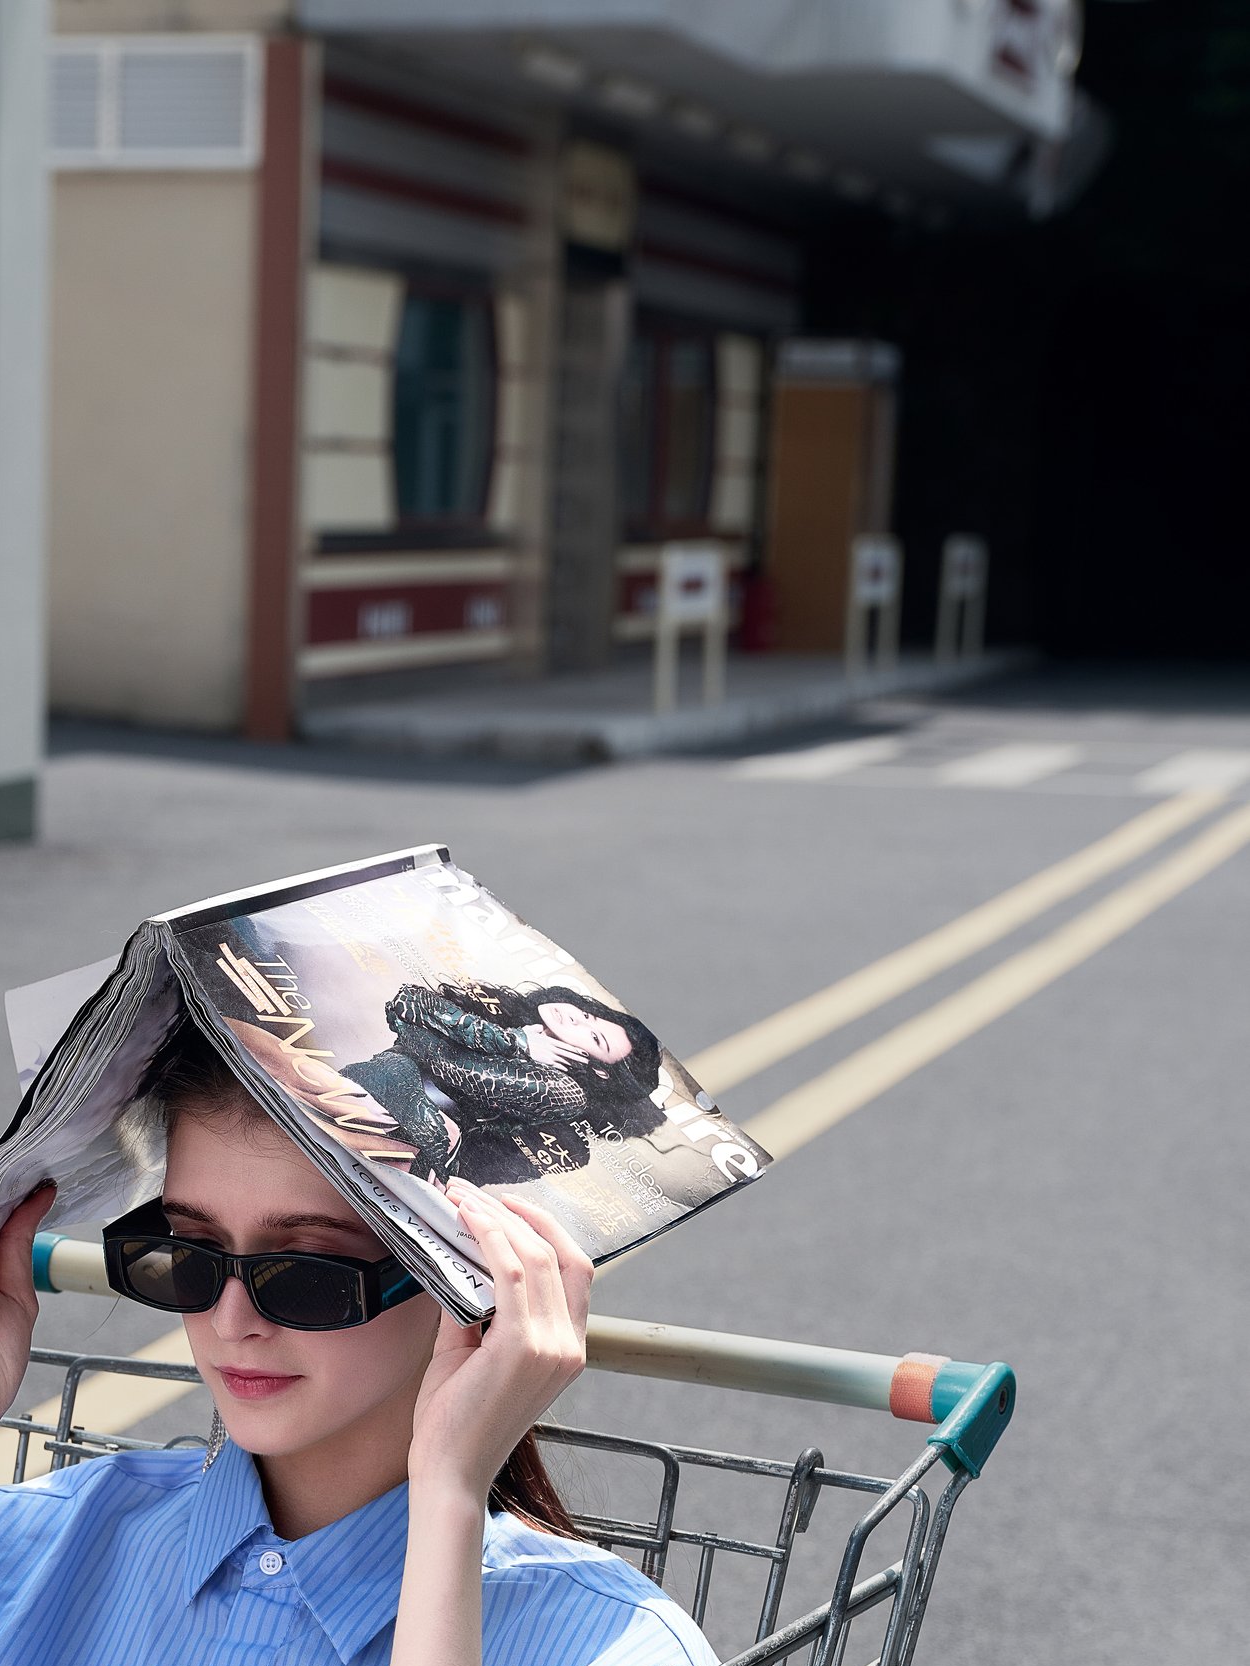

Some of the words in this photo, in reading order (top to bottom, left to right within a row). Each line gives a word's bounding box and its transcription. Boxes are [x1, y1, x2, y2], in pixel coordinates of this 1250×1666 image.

[255, 954, 312, 1011] The
[256, 1014, 386, 1135] New
[569, 1121, 595, 1149] Furry
[579, 1120, 601, 1143] Pink
[598, 1142, 624, 1170] Lady
[599, 1121, 631, 1154] 101
[625, 1153, 672, 1207] ideas
[352, 1162, 401, 1213] LOUIS
[407, 1216, 484, 1290] VUITTON
